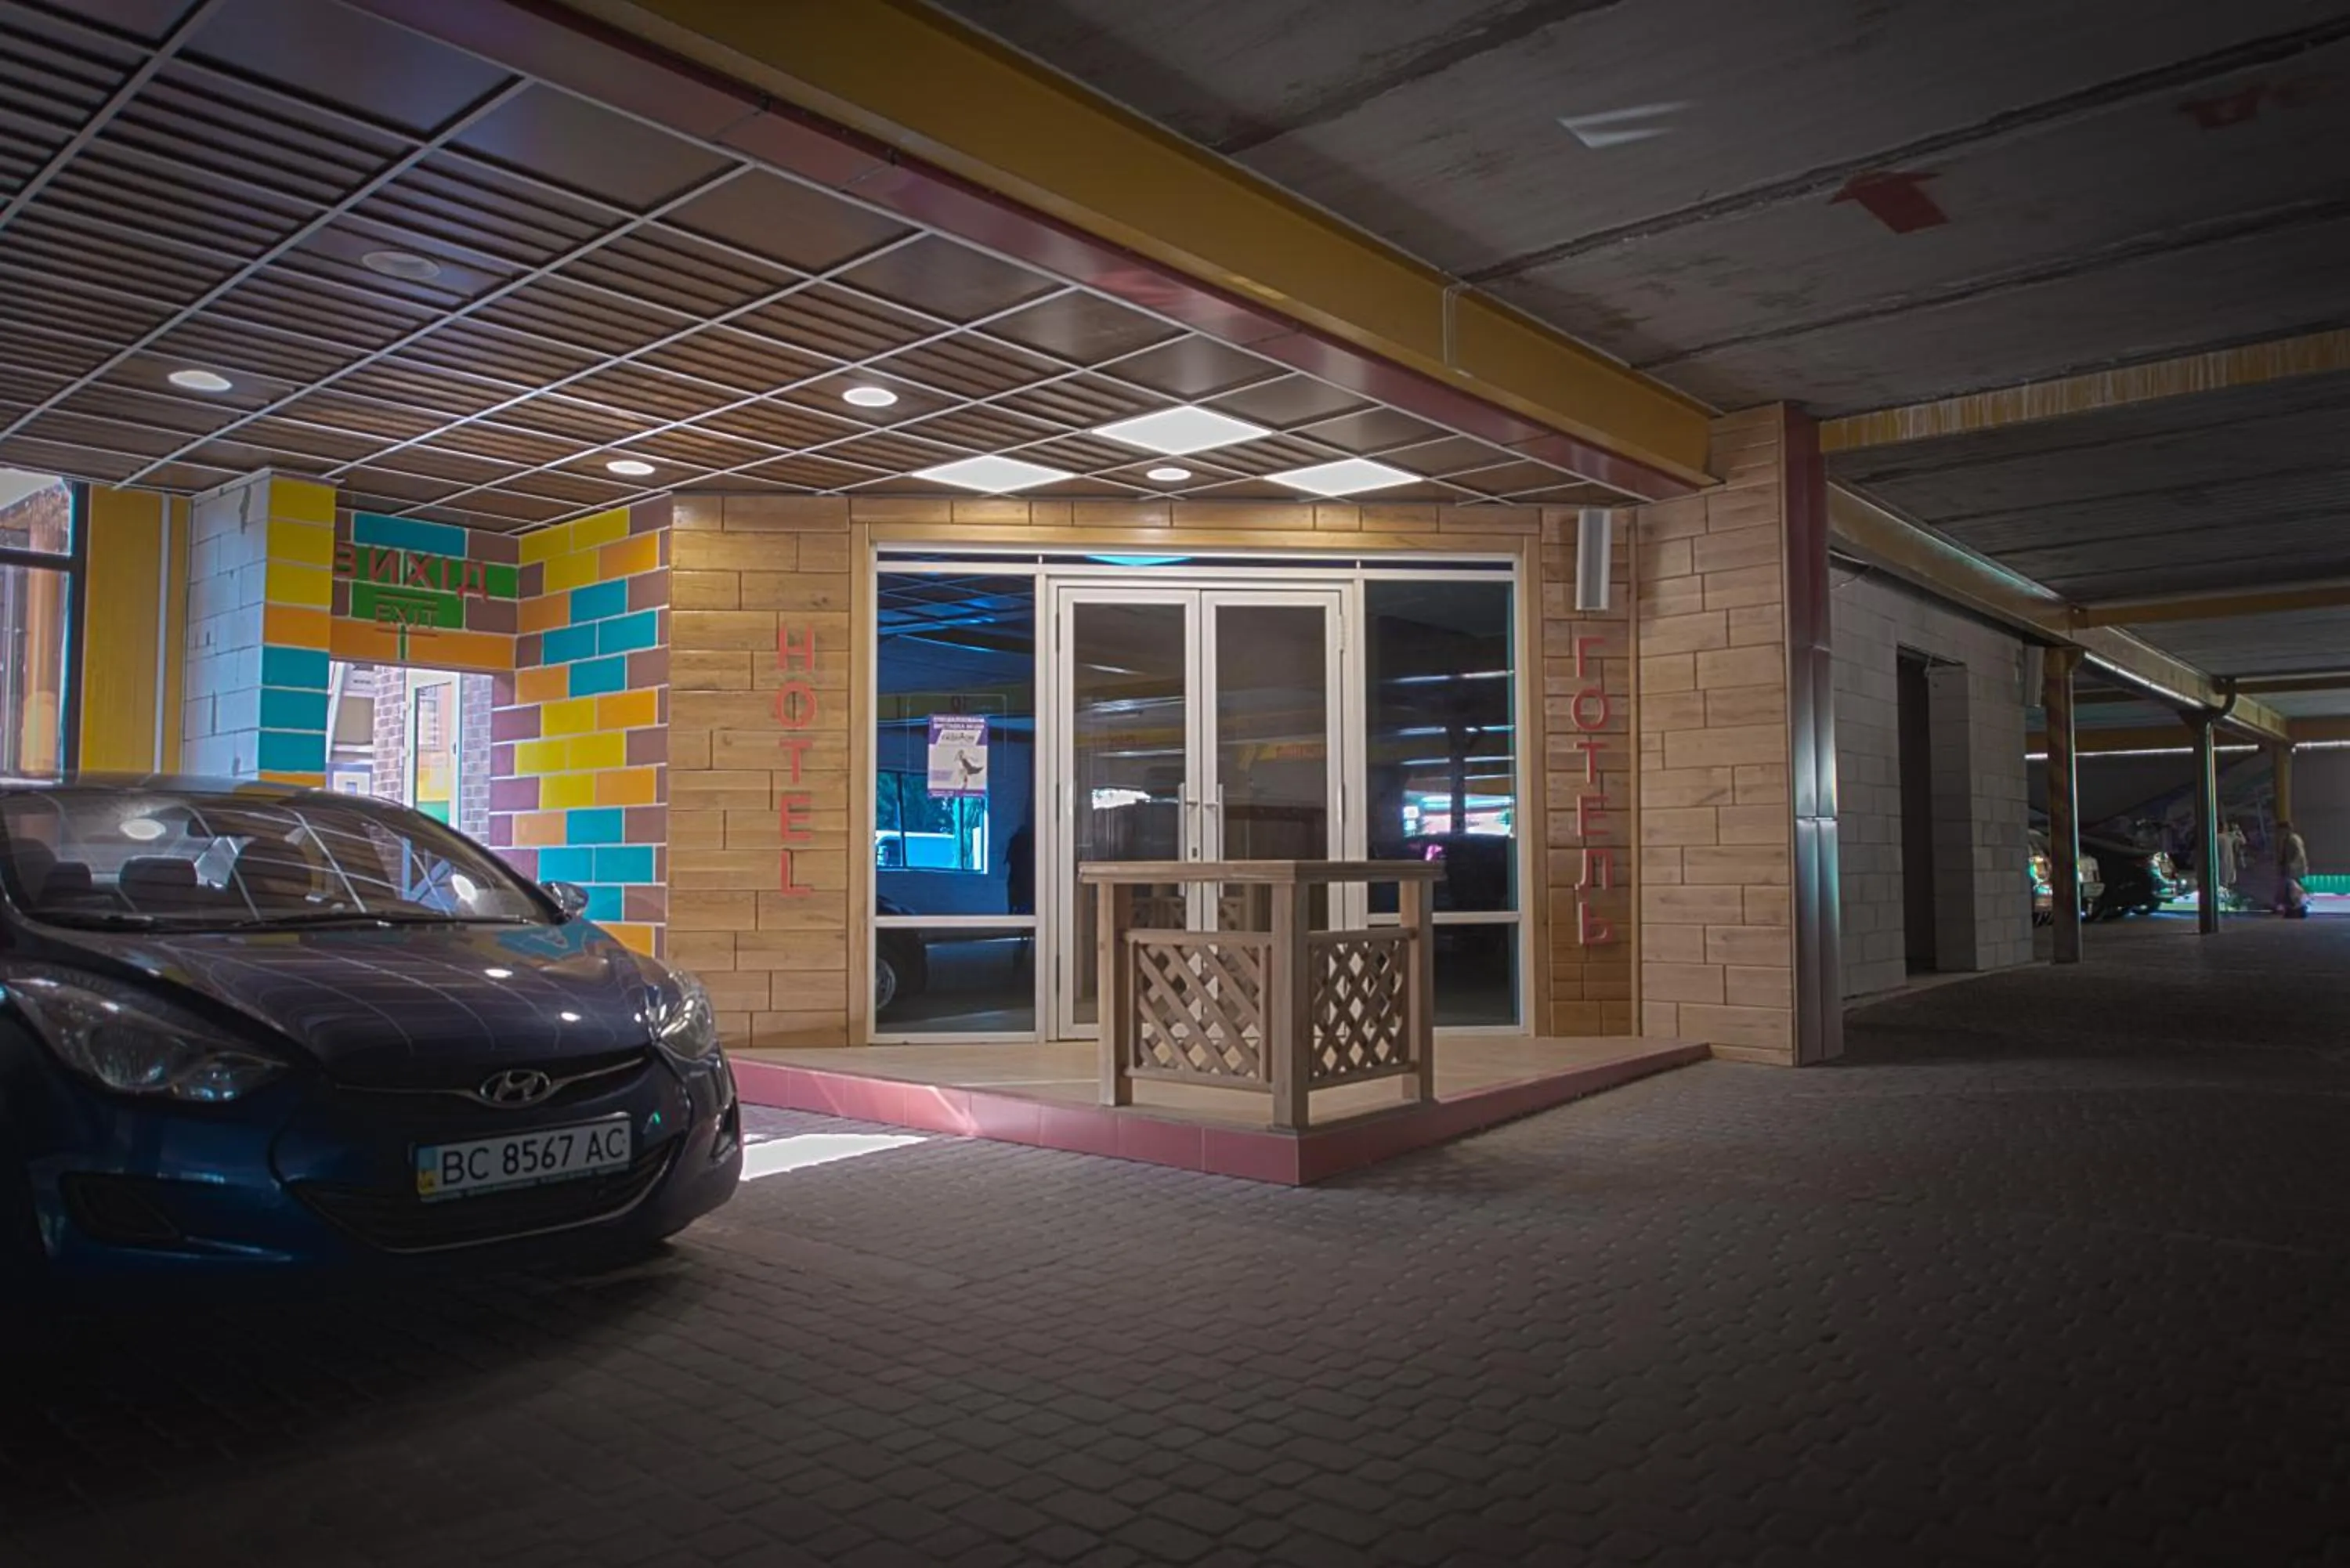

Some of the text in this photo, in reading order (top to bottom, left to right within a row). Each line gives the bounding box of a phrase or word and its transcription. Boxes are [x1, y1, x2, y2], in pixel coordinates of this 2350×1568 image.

[375, 602, 438, 629] EXIT
[775, 626, 816, 896] HOTEL
[1571, 637, 1614, 945] ГОТЕЛЬ
[442, 1147, 489, 1186] BC
[502, 1136, 575, 1175] 8567
[586, 1128, 624, 1165] AC
